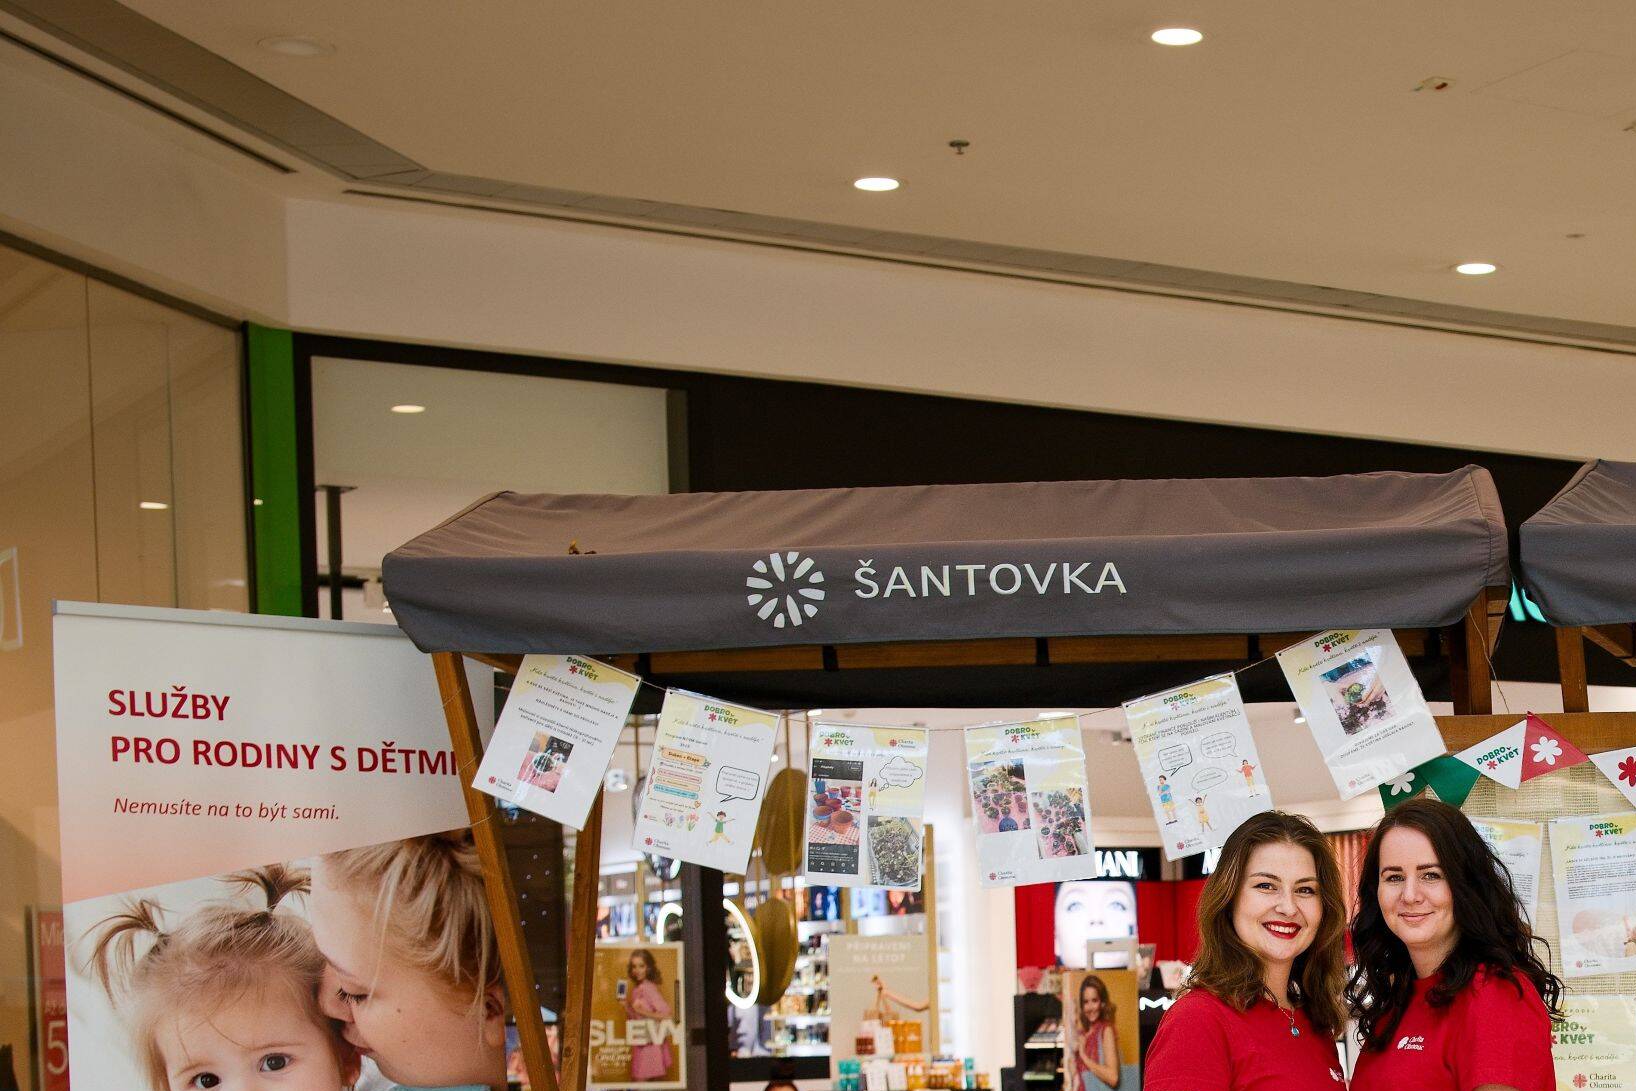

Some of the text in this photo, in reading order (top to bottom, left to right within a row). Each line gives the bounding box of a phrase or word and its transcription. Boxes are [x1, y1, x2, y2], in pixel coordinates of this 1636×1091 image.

[854, 558, 1127, 599] ŠANTOVKA
[108, 685, 231, 721] SLUŽBY
[111, 736, 182, 765] PRO
[193, 739, 321, 770] RODINY
[331, 746, 347, 772] S
[114, 797, 340, 823] Nemusíte na to být sami.
